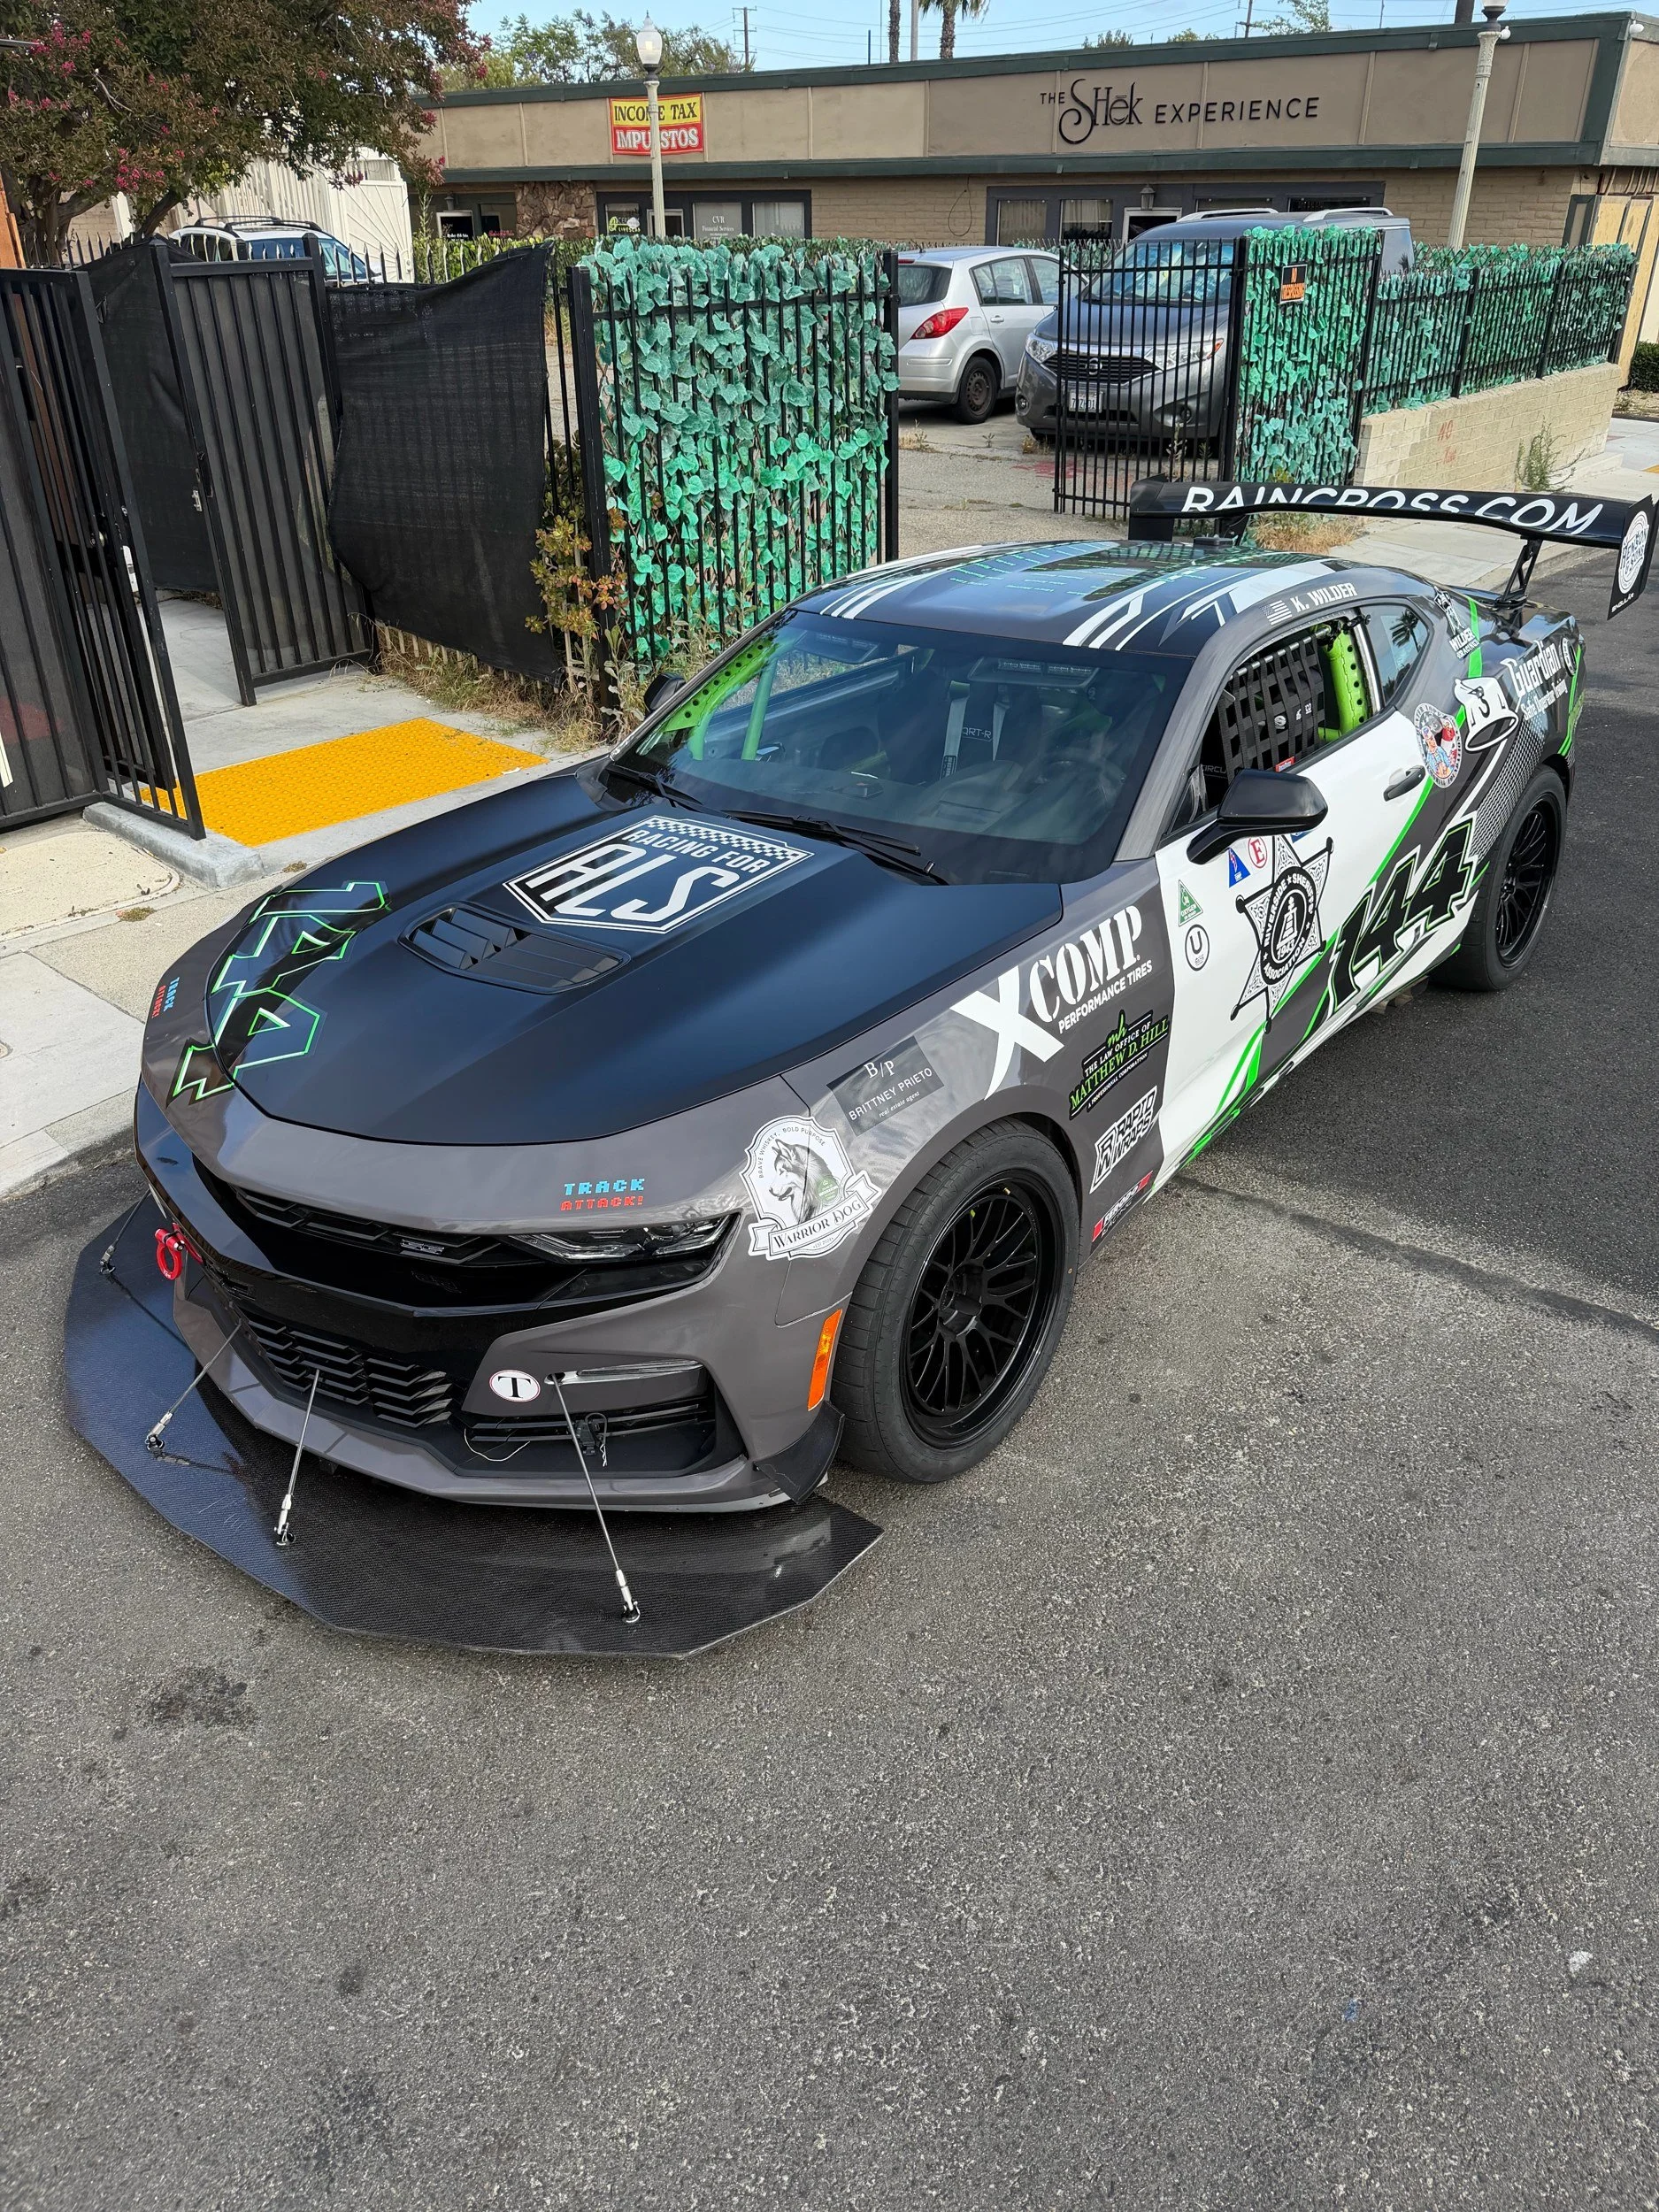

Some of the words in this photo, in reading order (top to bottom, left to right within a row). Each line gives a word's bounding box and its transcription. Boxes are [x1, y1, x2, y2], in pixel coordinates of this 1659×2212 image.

[670, 102, 697, 120] TAX
[1040, 91, 1065, 104] THE
[1154, 96, 1320, 124] EXPERIENCE
[616, 127, 699, 150] IMPUSTOS
[1290, 595, 1310, 613] K.
[1307, 582, 1358, 607] WILDER
[1448, 626, 1476, 653] WILDER
[1500, 639, 1563, 699] Guardian
[621, 829, 716, 858] RACING
[711, 851, 772, 874] FOR
[1250, 838, 1265, 864] E
[526, 842, 741, 922] ALS
[1263, 879, 1288, 948] RIVERSIDE
[1330, 816, 1474, 1015] 144
[1189, 931, 1202, 955] U
[1263, 936, 1306, 980] ASSOCIATION
[1058, 983, 1126, 1033] PERFORMANCE
[1126, 959, 1153, 987] TIRES
[1071, 1048, 1127, 1110] MATTHEW
[1128, 1041, 1138, 1058] D.
[1140, 1018, 1169, 1048] HILL
[1084, 1060, 1098, 1078] THE
[1099, 1048, 1114, 1065] LAW
[1115, 1029, 1140, 1052] OFFICE
[1141, 1021, 1151, 1033] OF
[849, 1087, 897, 1121] BRITTNEY
[898, 1067, 933, 1092] PRIETO
[1091, 1076, 1118, 1106] PROFESSIONAL
[1118, 1051, 1148, 1078] CORPORATION
[879, 1107, 890, 1118] real
[890, 1099, 906, 1111] estate
[905, 1091, 920, 1104] agent
[1117, 1089, 1156, 1137] RAPID
[801, 1126, 826, 1147] PURPOSE
[1112, 1112, 1152, 1164] WRAPS
[560, 1195, 644, 1211] ATTACK!
[564, 1178, 645, 1195] TRACK
[772, 1217, 831, 1249] WARRIOR
[833, 1199, 862, 1226] DOG
[497, 1376, 532, 1399] T
